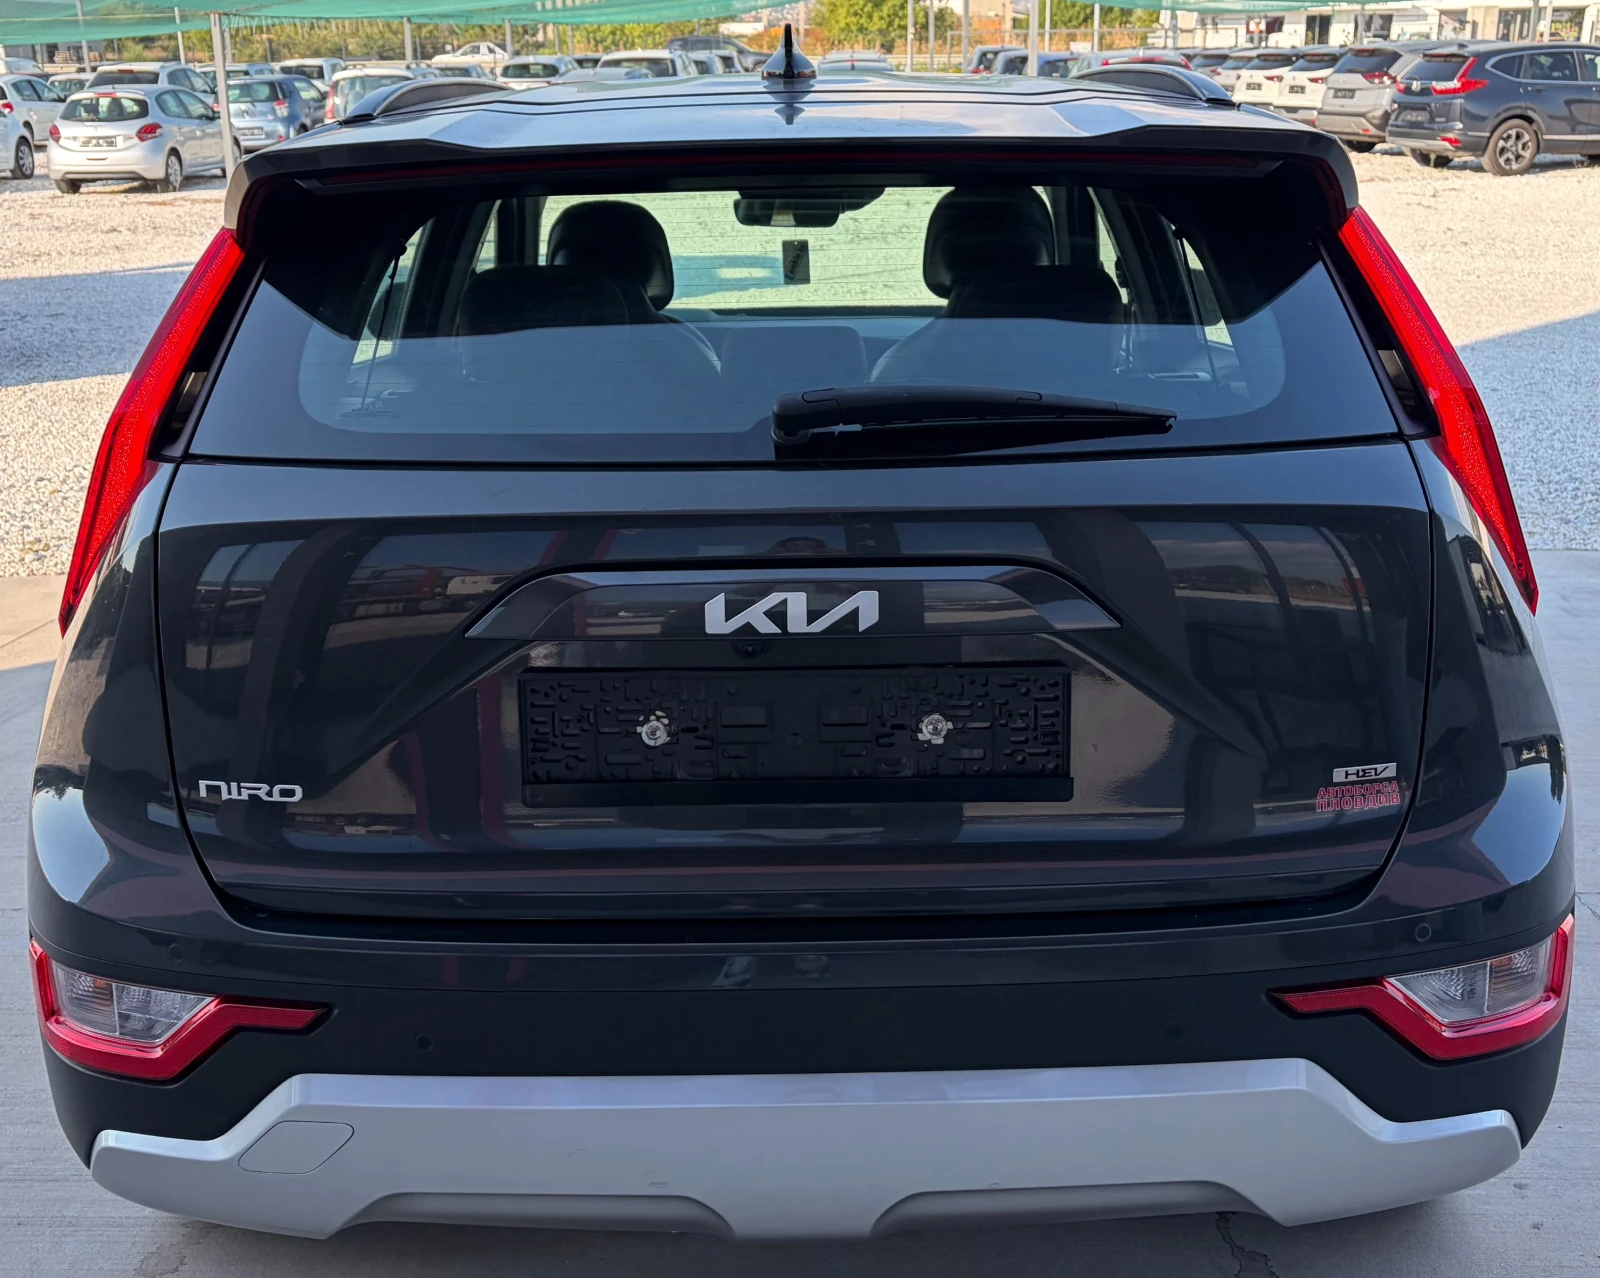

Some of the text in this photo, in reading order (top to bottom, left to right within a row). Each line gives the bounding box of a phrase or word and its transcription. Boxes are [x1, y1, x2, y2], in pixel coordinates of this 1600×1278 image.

[705, 591, 879, 634] KIA
[1345, 766, 1389, 779] HEV
[199, 780, 302, 802] NIRO
[1317, 781, 1399, 799] АВТОБОРСА
[1316, 792, 1401, 812] ПЛОВДИВ
